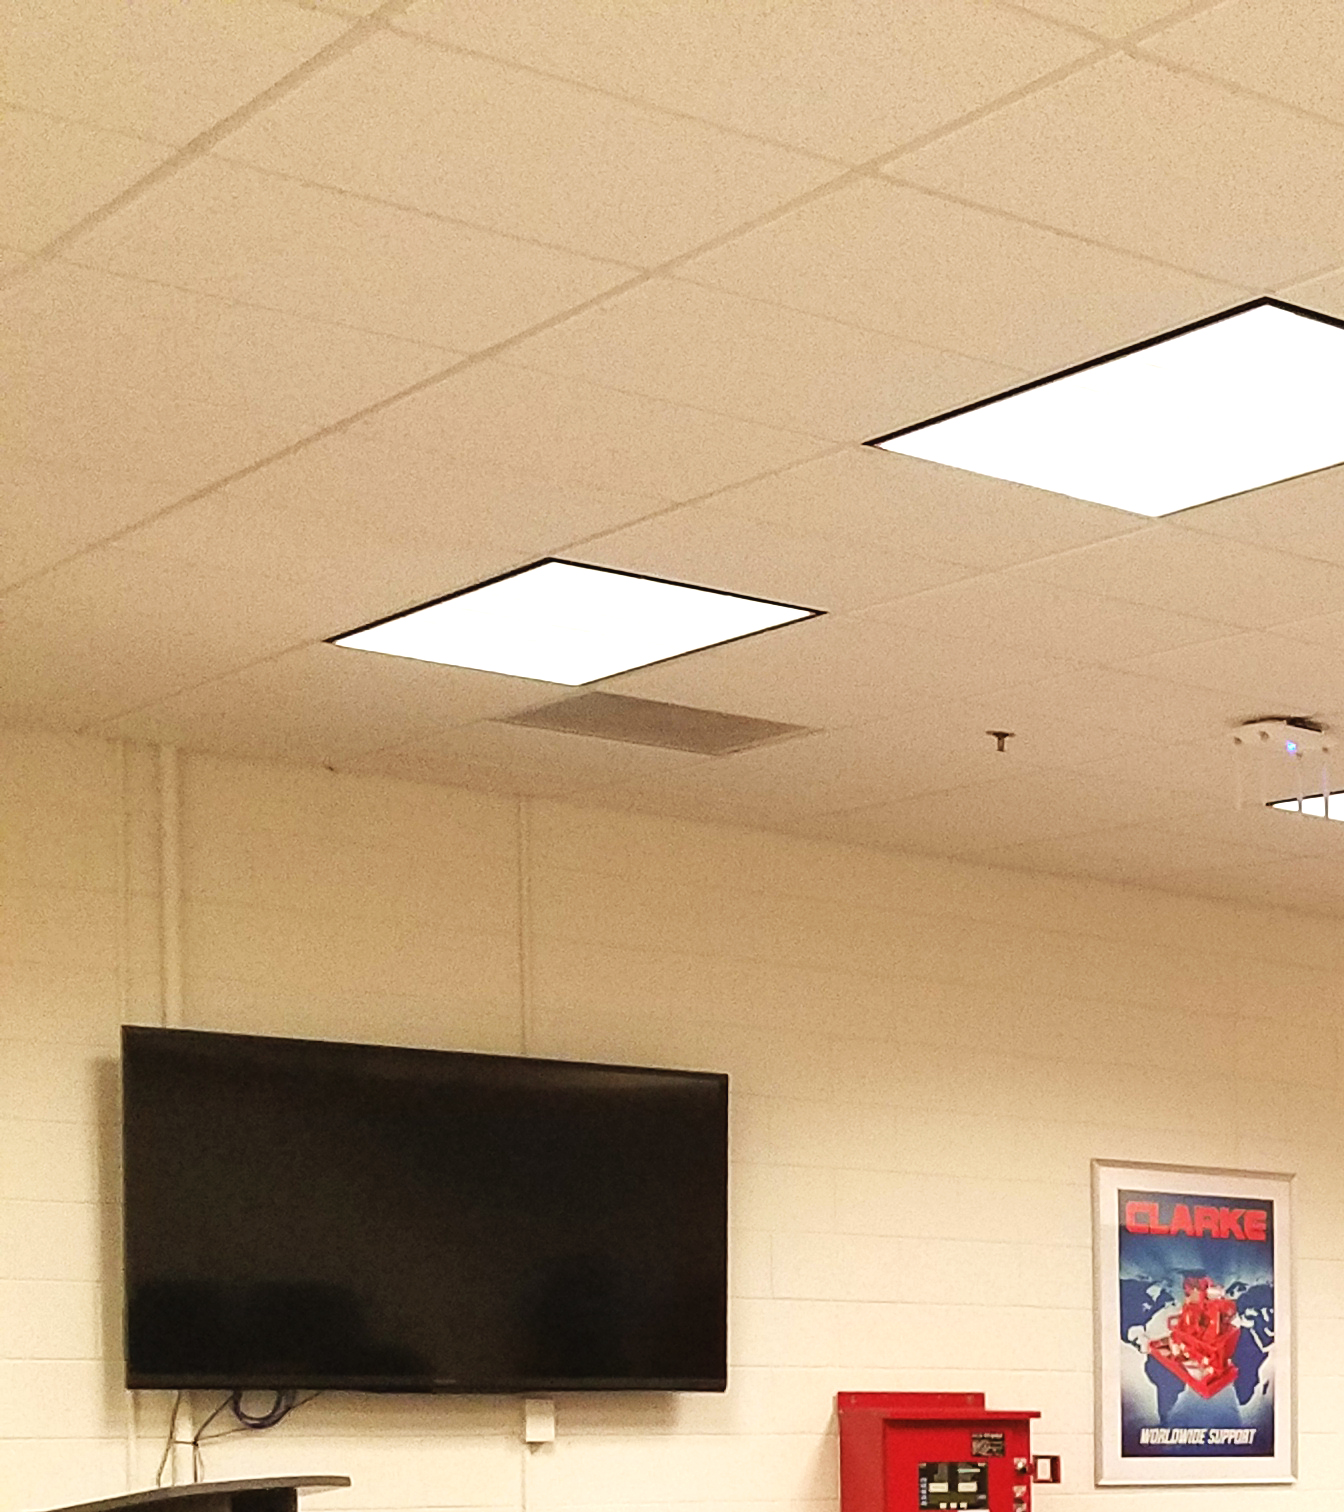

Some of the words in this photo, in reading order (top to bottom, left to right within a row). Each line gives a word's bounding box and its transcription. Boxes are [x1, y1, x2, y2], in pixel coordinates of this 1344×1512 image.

[1125, 1201, 1267, 1241] CLARKE
[1139, 1427, 1207, 1445] WORLDWIDE
[1207, 1428, 1257, 1445] SUPPORT
